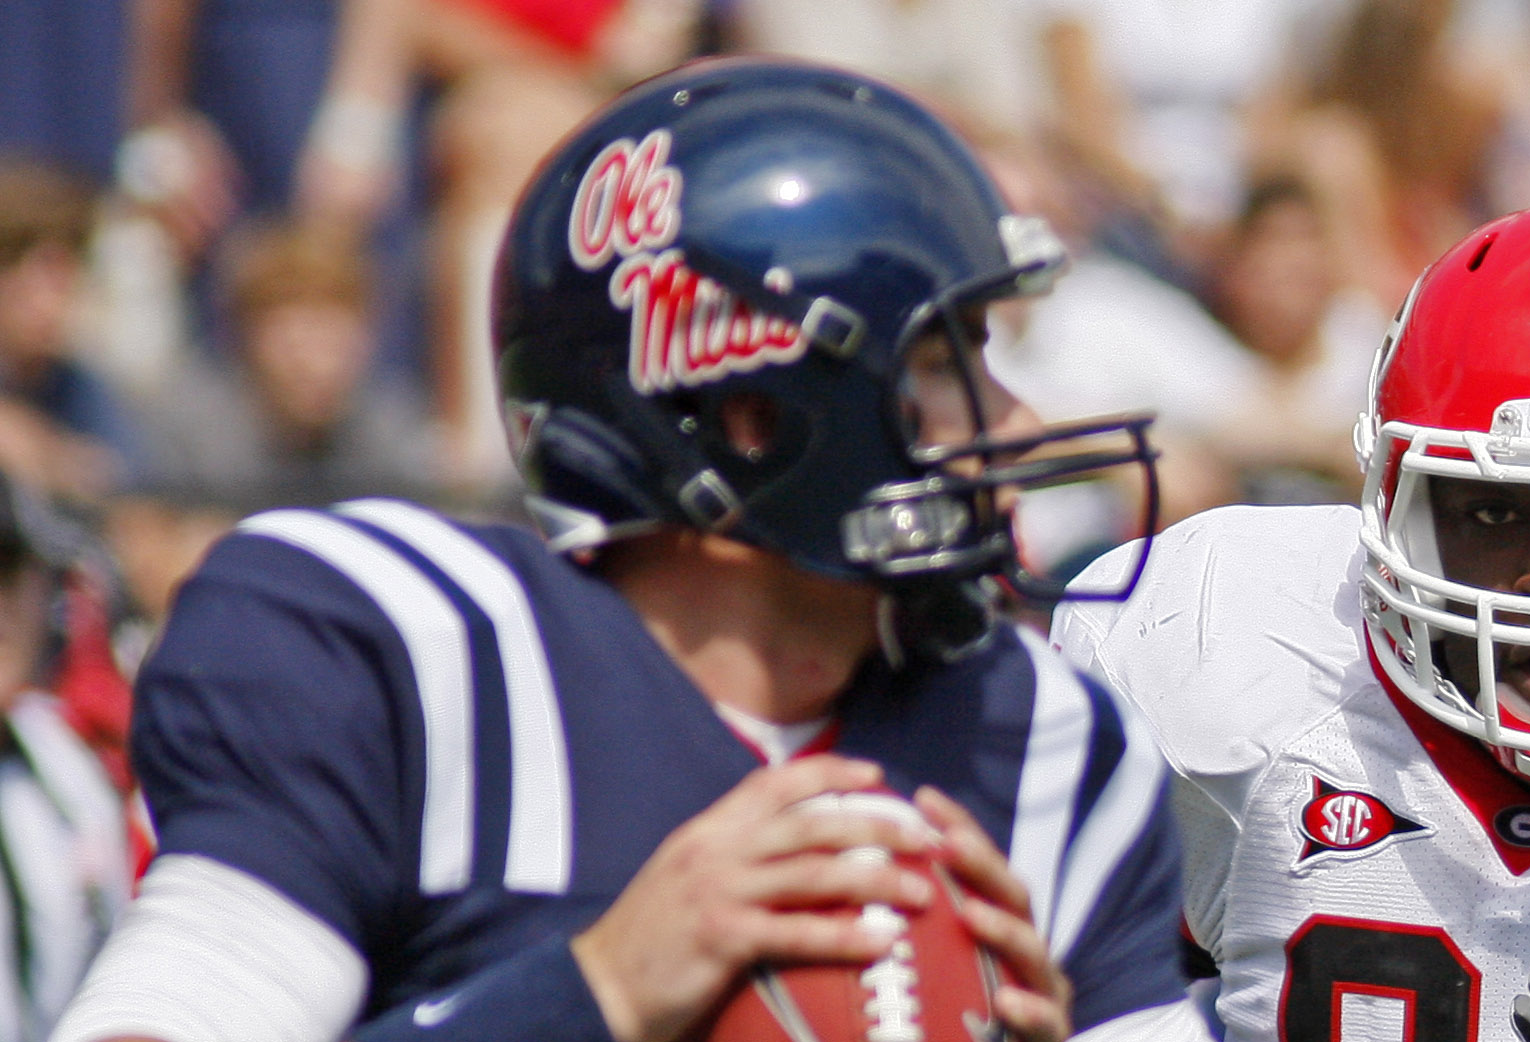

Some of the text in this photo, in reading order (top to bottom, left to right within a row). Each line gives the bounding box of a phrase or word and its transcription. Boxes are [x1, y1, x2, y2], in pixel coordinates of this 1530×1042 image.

[569, 129, 683, 271] Ole
[610, 249, 806, 394] Miss
[1320, 795, 1372, 845] SEC
